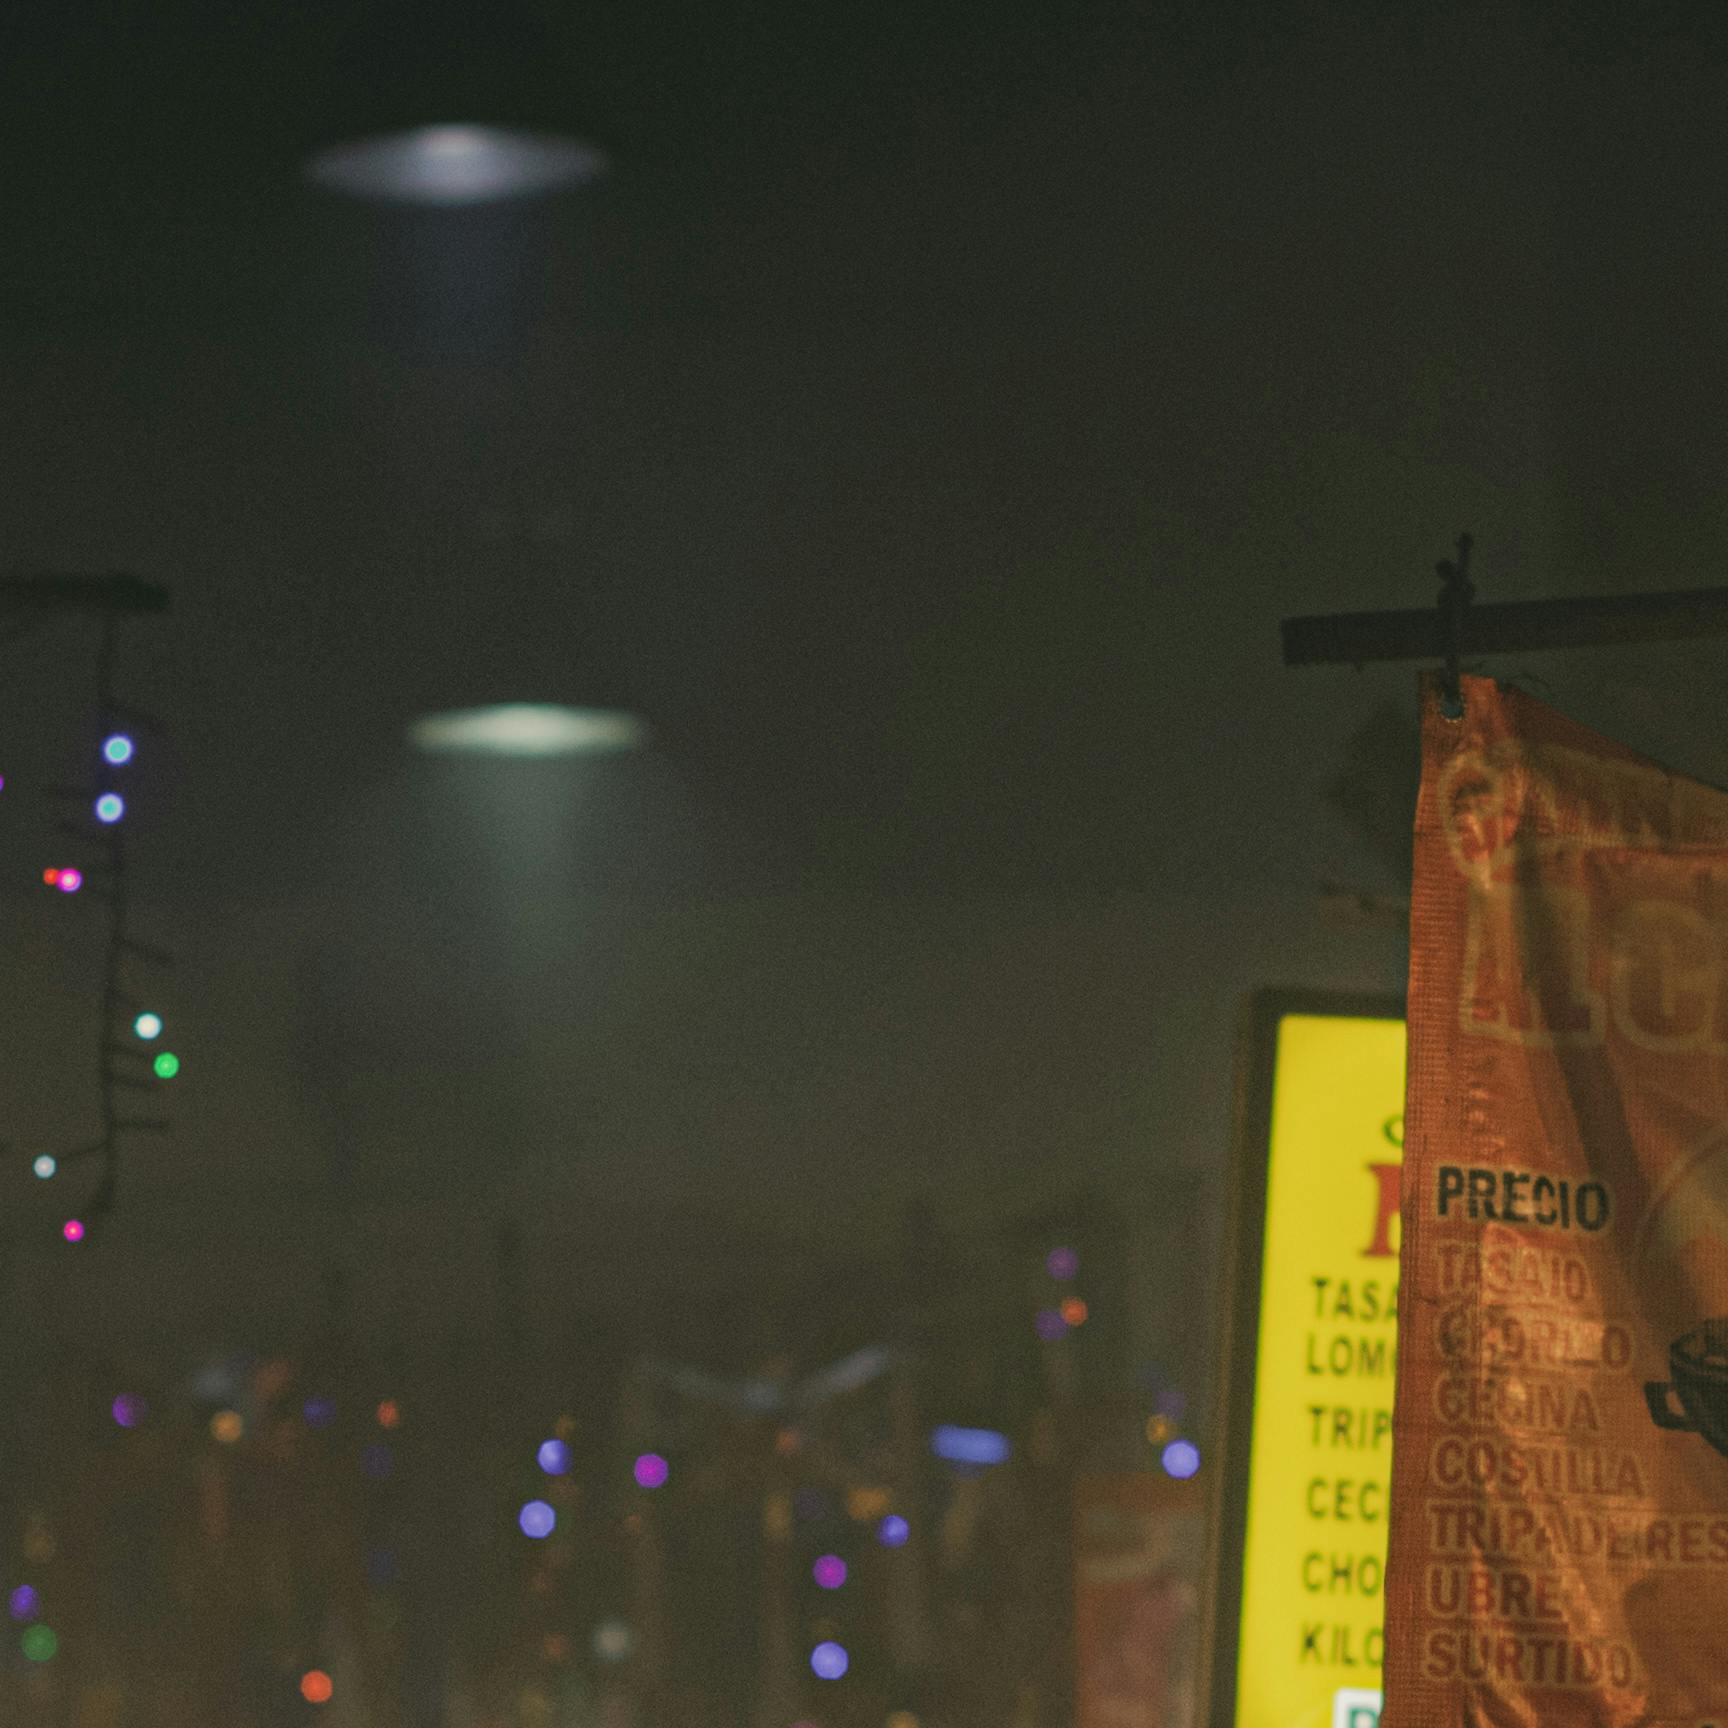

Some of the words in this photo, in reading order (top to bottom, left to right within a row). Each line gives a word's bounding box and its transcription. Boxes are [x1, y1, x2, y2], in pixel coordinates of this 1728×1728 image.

[1437, 1166, 1611, 1232] PRECIO
[1305, 1331, 1396, 1376] LOM
[1436, 1378, 1602, 1434] CECINA
[1435, 1439, 1643, 1498] COSTILLA
[1306, 1478, 1390, 1522] CEC
[1430, 1566, 1562, 1621] UBRE
[1424, 1632, 1634, 1691] SURTIDO
